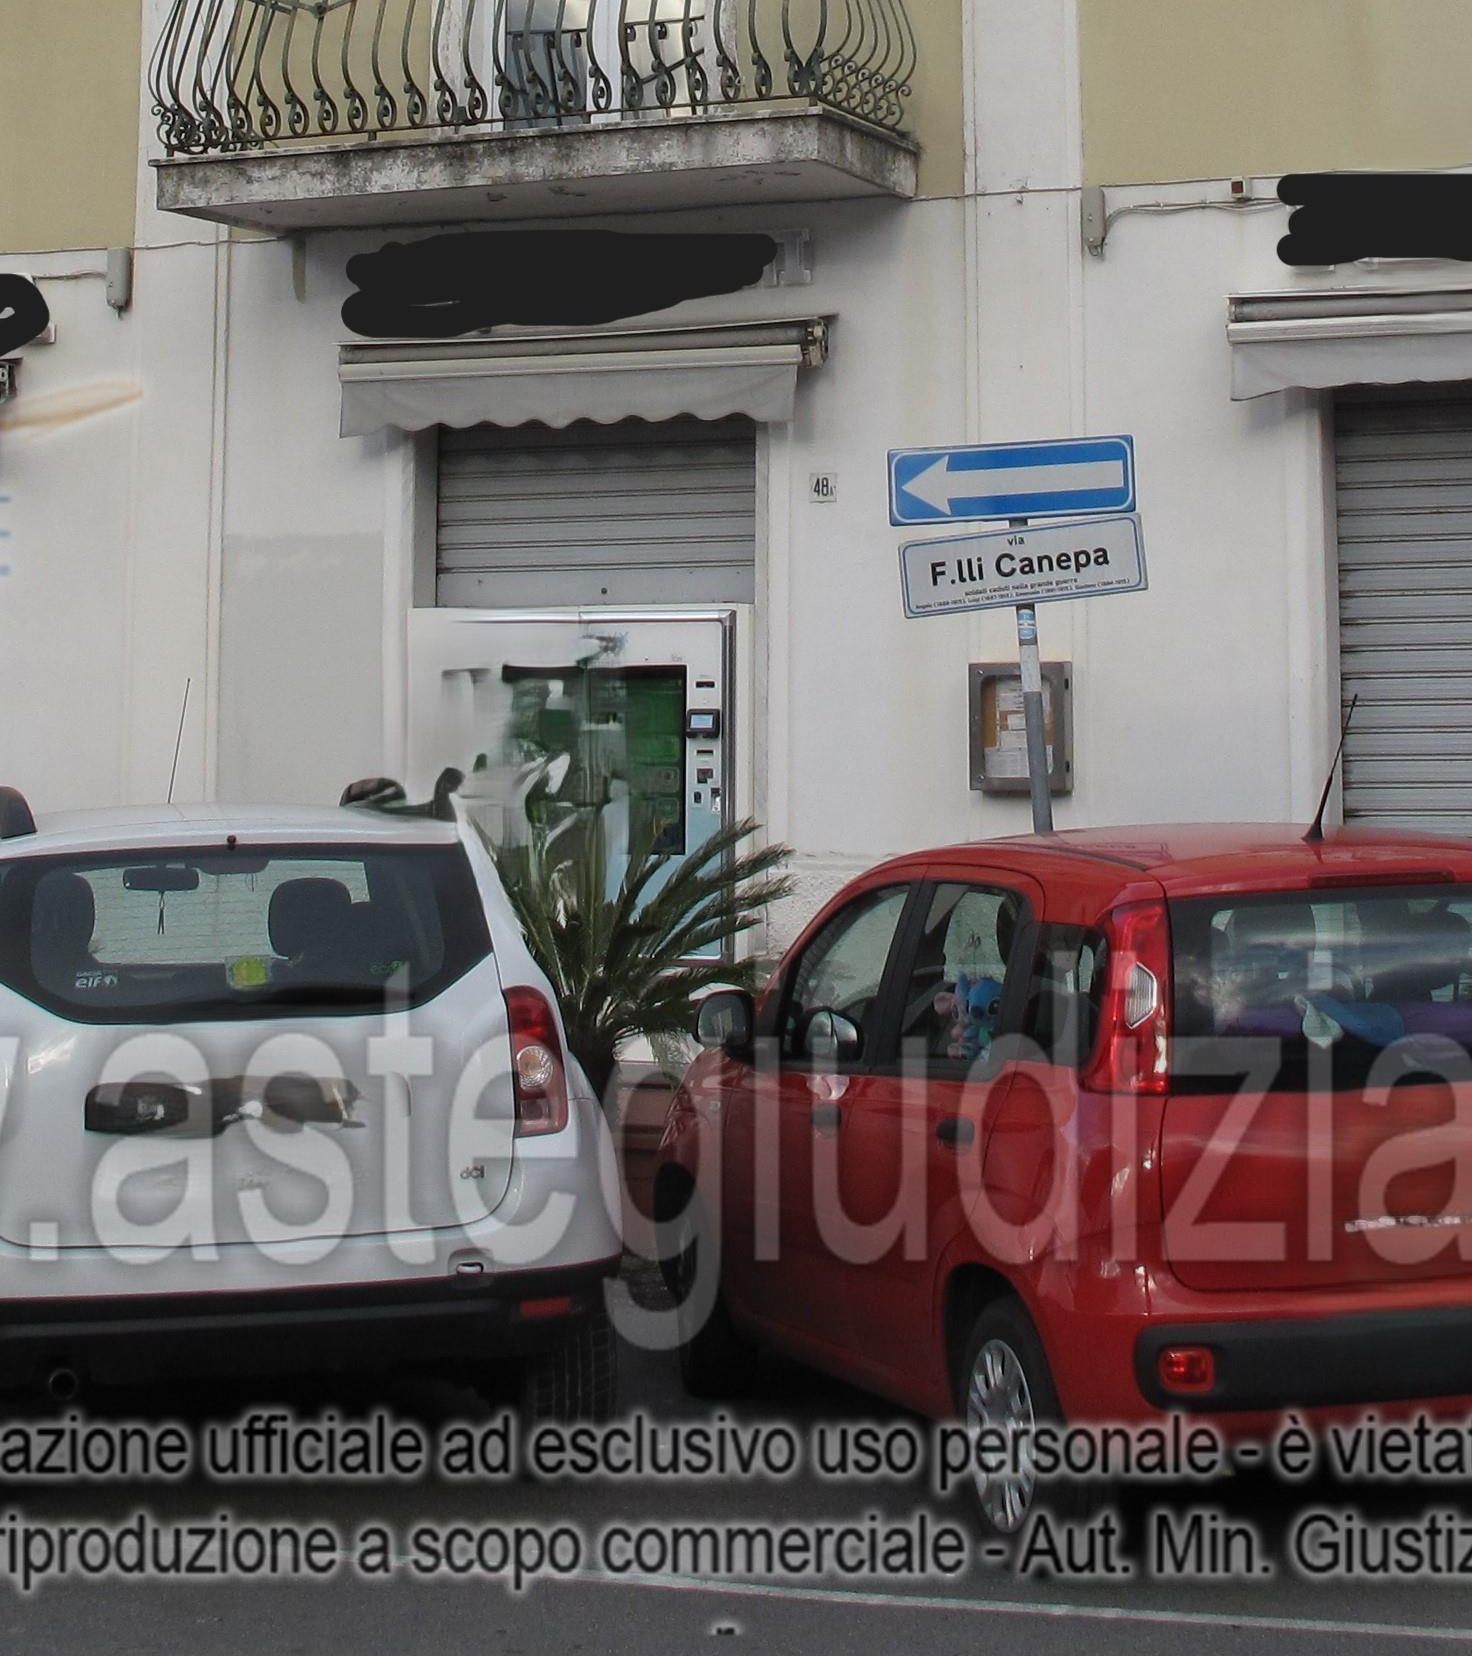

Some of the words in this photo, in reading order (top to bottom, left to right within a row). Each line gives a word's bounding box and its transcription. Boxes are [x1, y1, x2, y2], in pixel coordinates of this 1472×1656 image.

[1007, 535, 1025, 546] via
[930, 557, 984, 586] F.lli
[995, 546, 1110, 578] Canepa
[75, 977, 102, 988] elf
